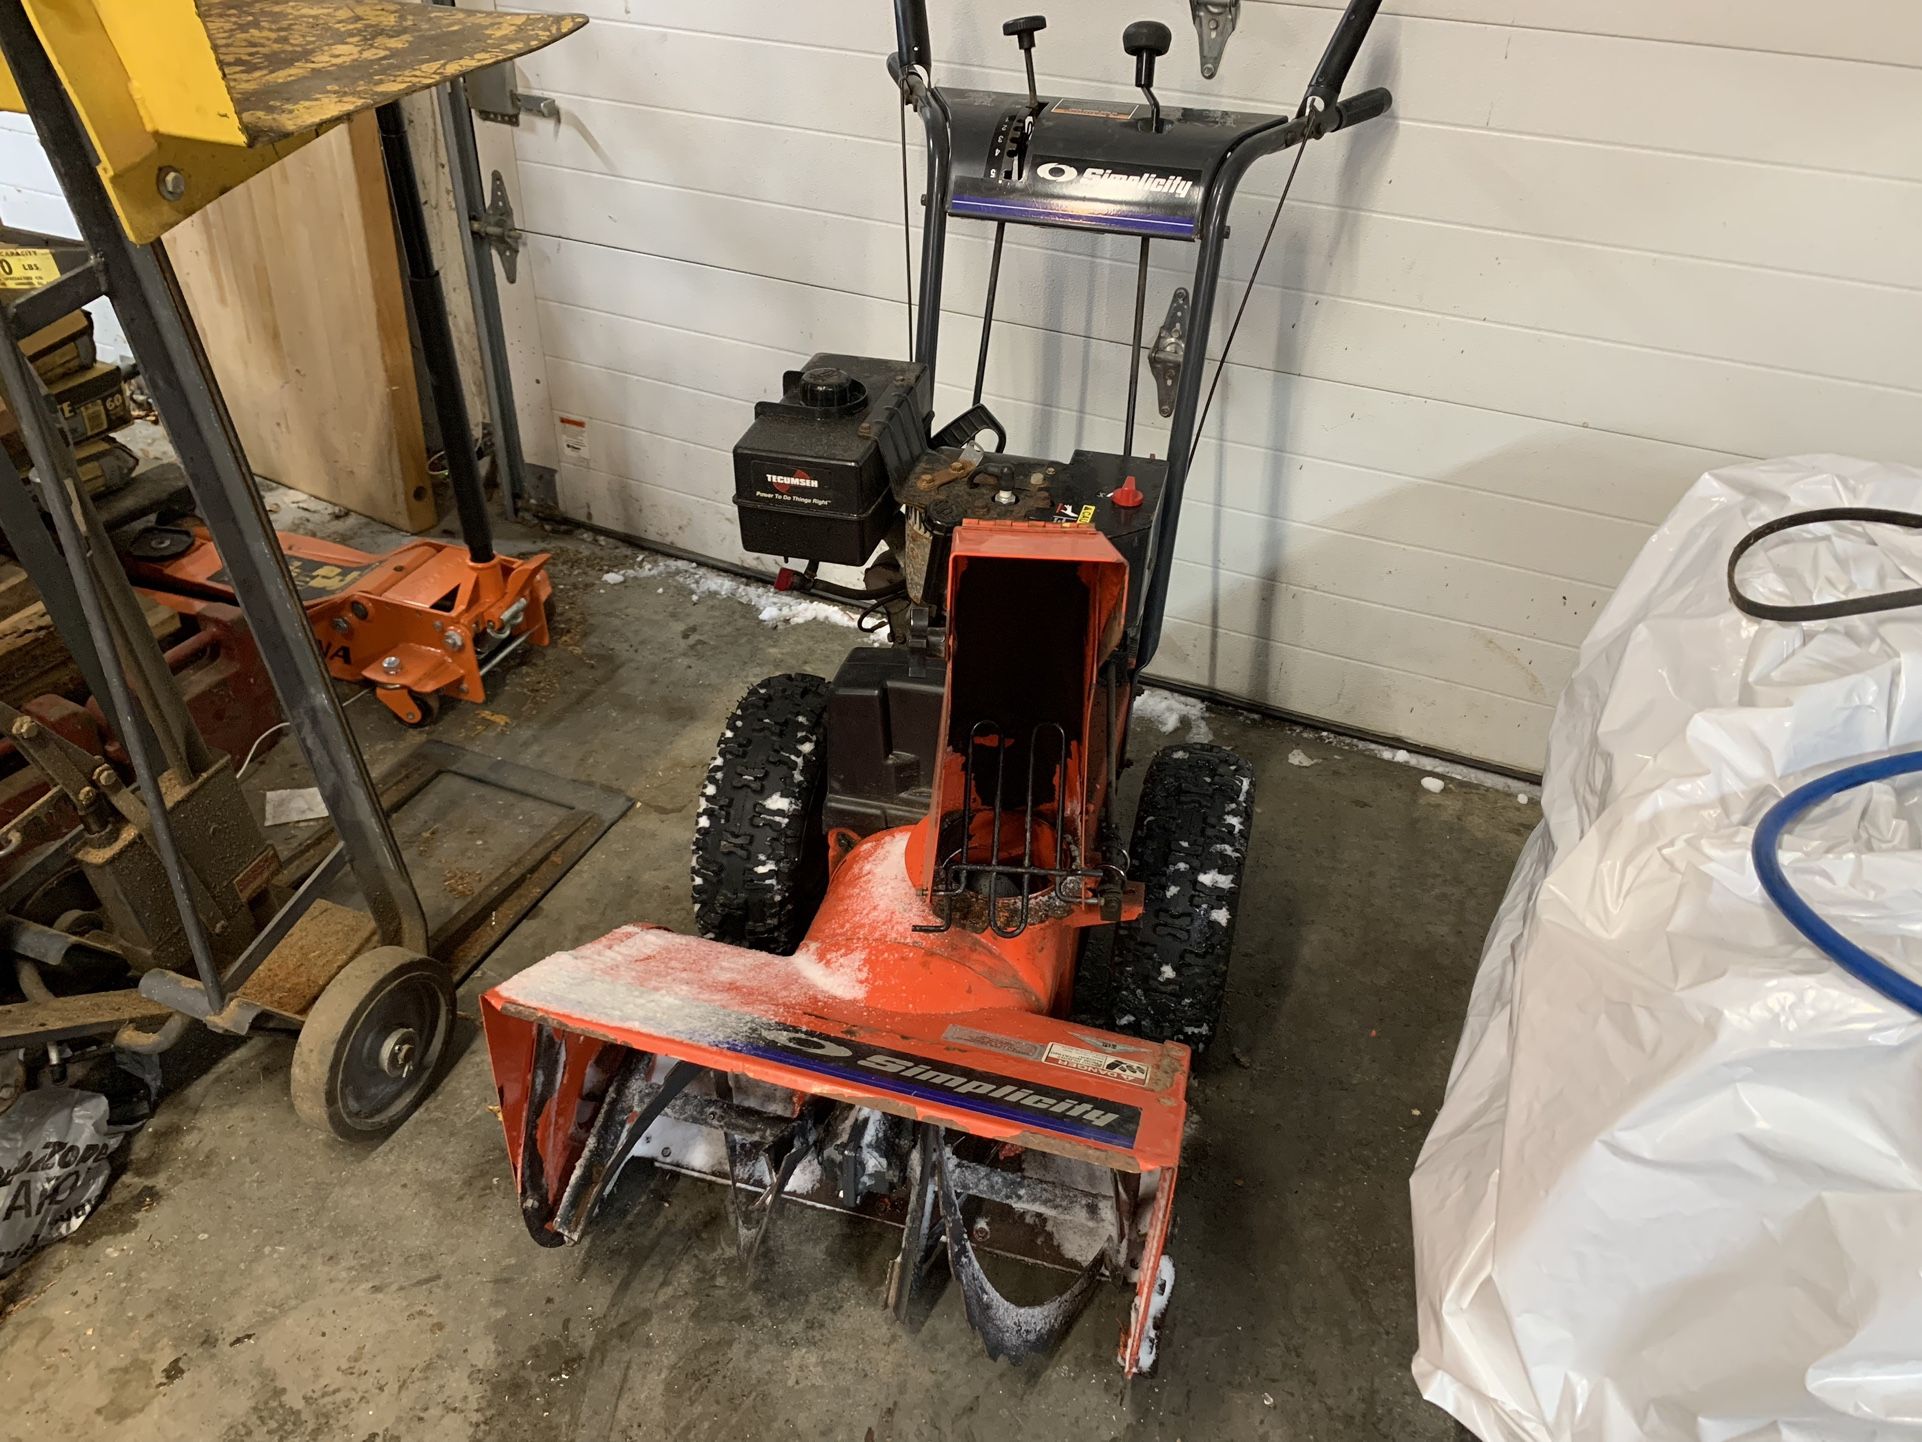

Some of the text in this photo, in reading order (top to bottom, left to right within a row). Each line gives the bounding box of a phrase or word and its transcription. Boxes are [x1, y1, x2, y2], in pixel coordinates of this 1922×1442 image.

[997, 135, 1004, 143] 3
[994, 147, 1001, 157] 4
[990, 168, 997, 178] 5
[1080, 167, 1193, 198] Simplicity
[106, 394, 122, 410] 60
[766, 473, 818, 488] TECUMSEH
[755, 490, 774, 498] Power
[792, 495, 811, 504] Things
[1057, 1060, 1118, 1078] DANGER
[857, 1055, 1119, 1127] Simplicity
